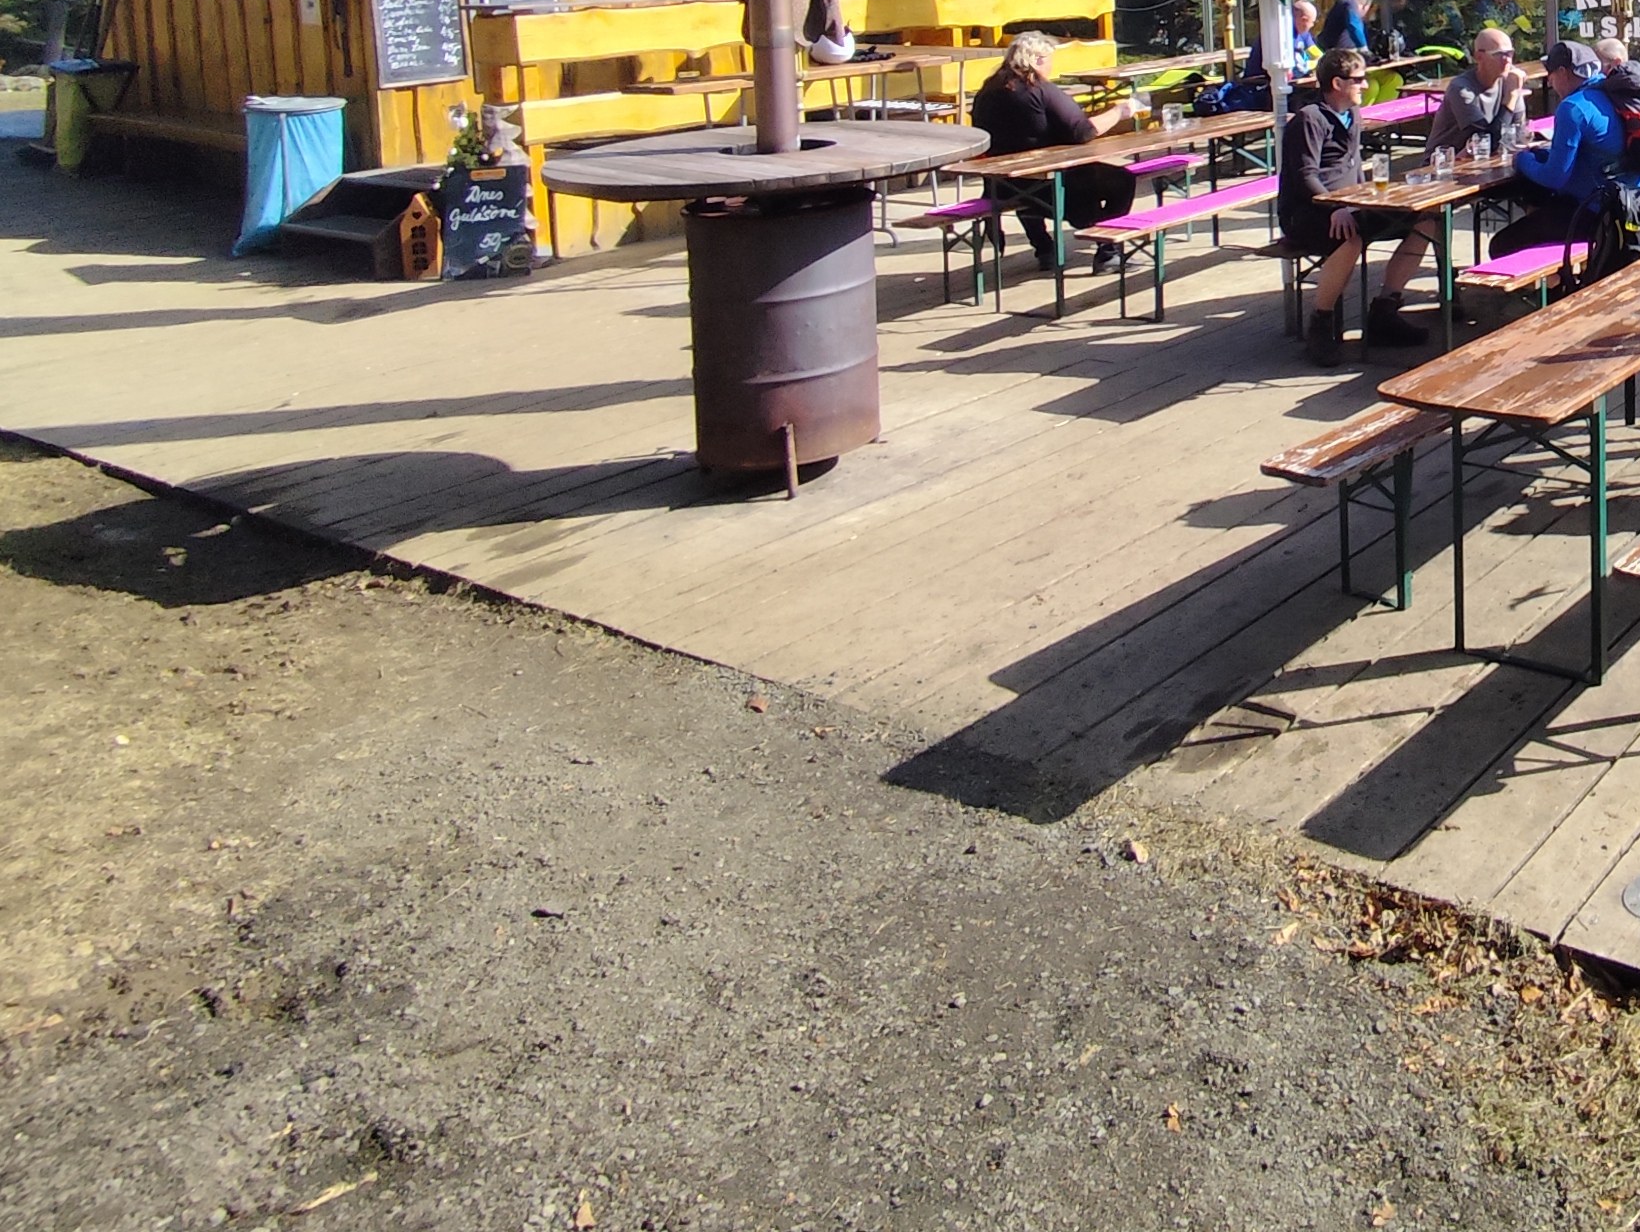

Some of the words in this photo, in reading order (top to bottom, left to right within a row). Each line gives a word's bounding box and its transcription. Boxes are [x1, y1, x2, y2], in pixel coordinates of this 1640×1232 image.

[1579, 21, 1594, 38] u
[465, 185, 504, 203] Dnes
[449, 199, 524, 231] Gulášová
